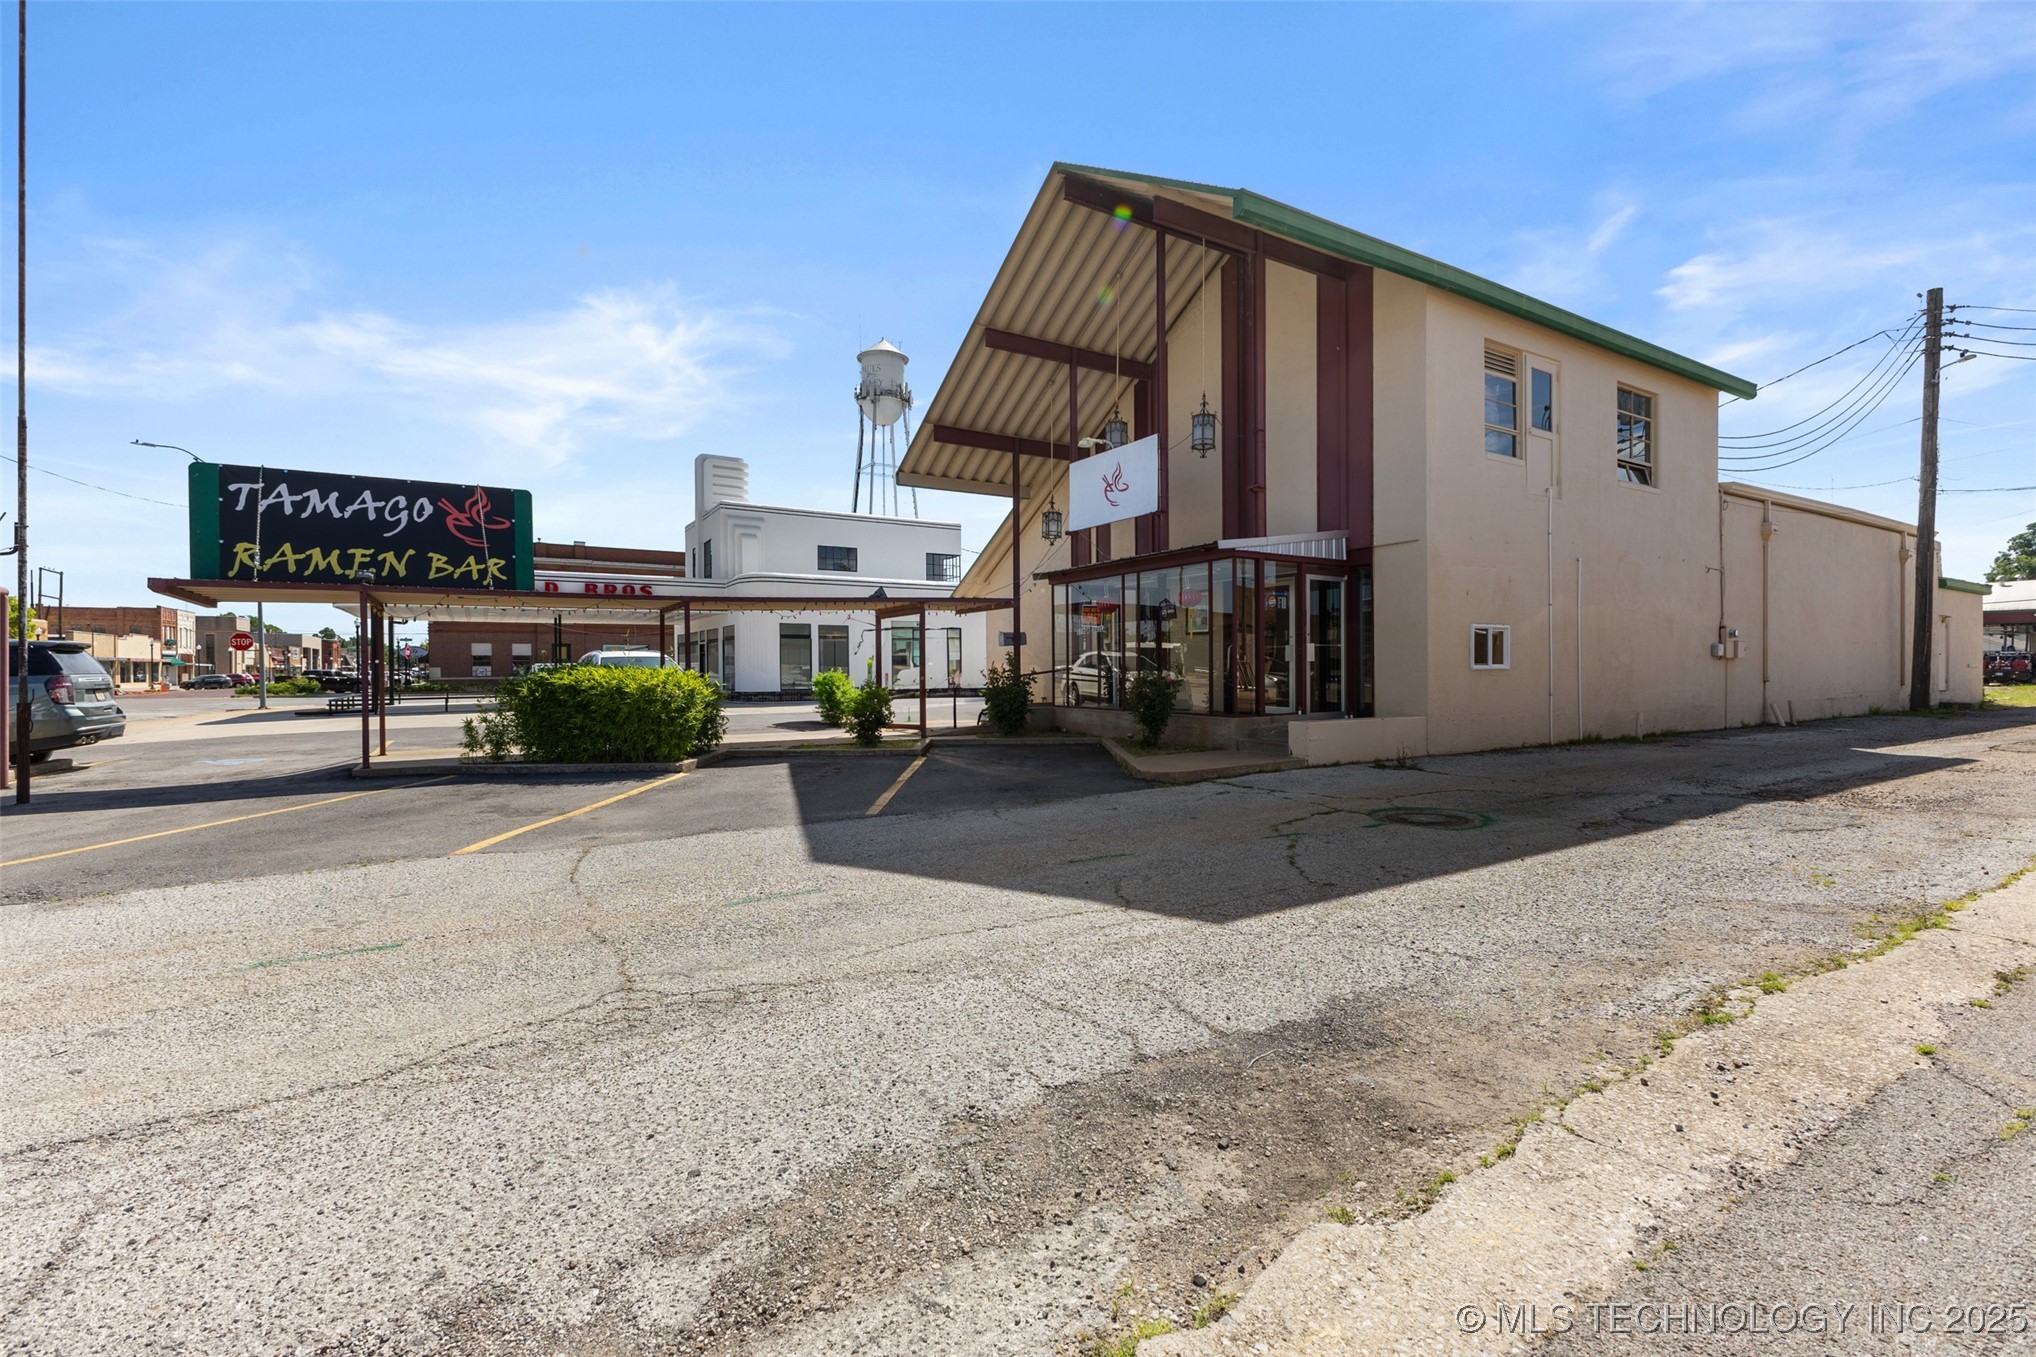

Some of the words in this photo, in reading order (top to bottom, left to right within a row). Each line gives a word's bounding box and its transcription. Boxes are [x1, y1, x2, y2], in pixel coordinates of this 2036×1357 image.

[227, 483, 434, 537] TAMAGO
[227, 542, 416, 580] RAMEN
[427, 552, 508, 586] BAR
[584, 582, 653, 596] BROS
[231, 638, 252, 646] STOP
